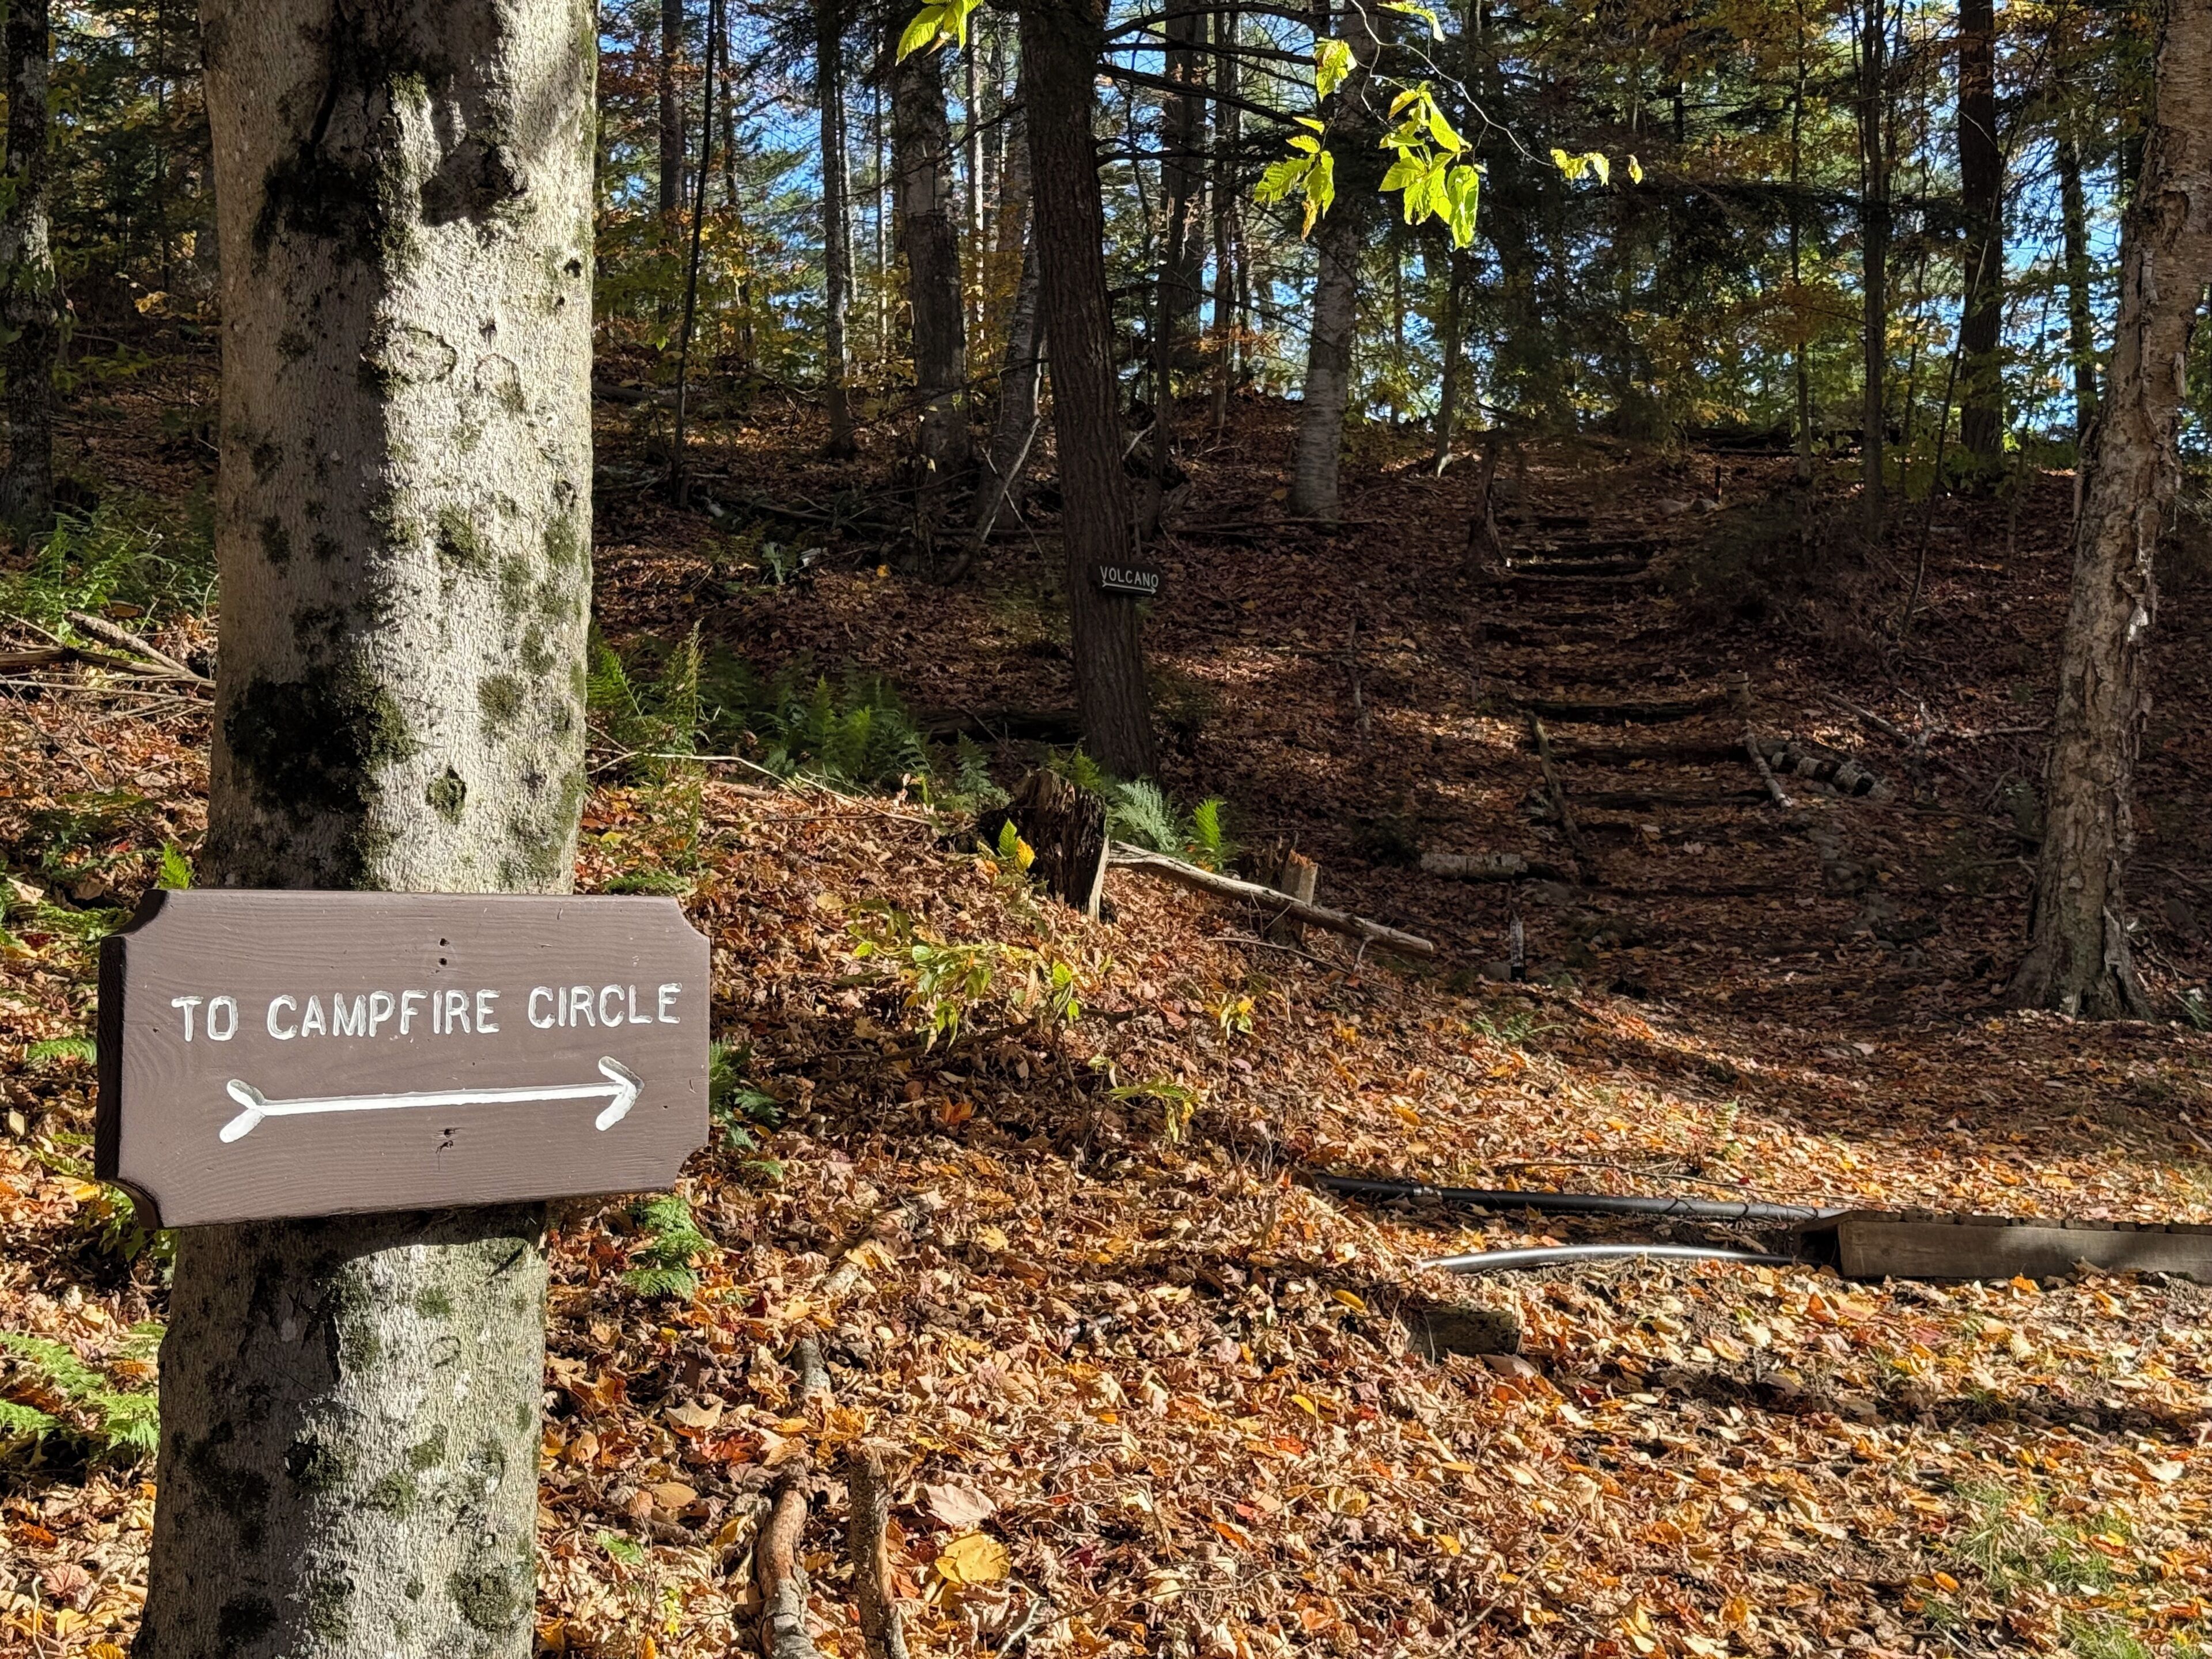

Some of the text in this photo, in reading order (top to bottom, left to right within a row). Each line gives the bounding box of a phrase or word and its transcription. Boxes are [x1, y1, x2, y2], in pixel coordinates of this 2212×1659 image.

[1100, 565, 1159, 588] VOLCANO
[171, 982, 682, 1042] TO CAMPFIRE CIRCLE
